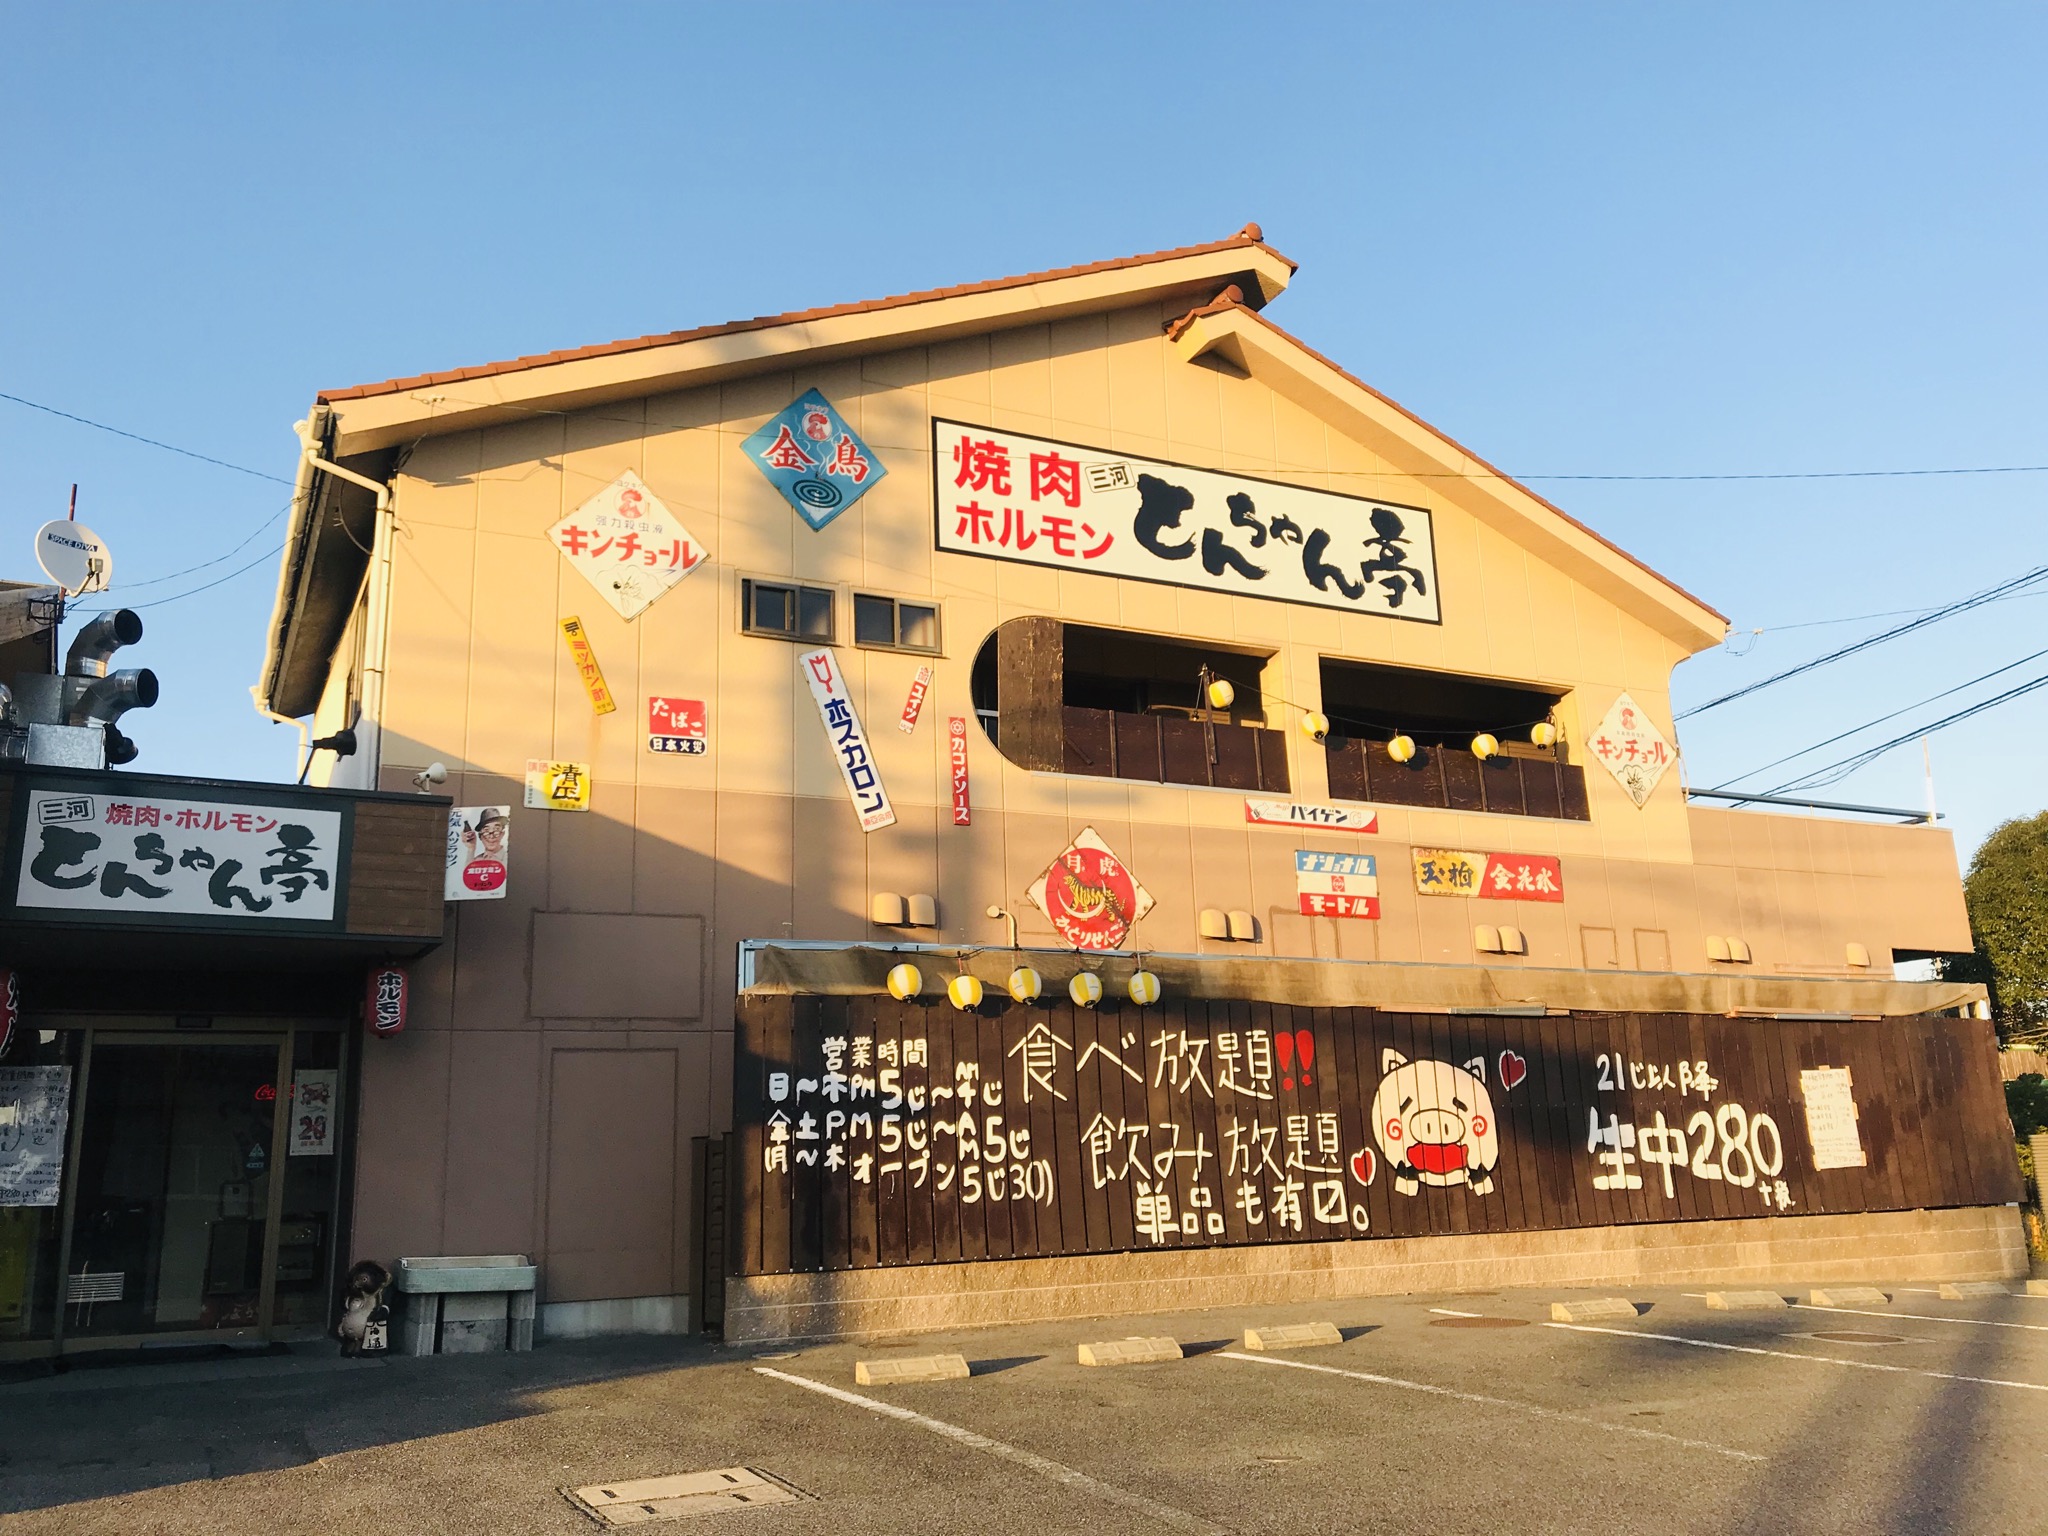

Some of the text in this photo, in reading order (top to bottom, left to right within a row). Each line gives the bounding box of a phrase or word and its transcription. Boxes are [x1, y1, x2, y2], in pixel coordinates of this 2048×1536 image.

[760, 423, 871, 484] 金鳥
[953, 435, 1082, 509] 焼肉
[1090, 465, 1129, 492] 三河
[561, 525, 698, 569] キンチョール
[954, 500, 1114, 560] ホルモン
[1133, 473, 1427, 609] とんちゃん亭
[652, 698, 704, 737] たばこ
[653, 738, 702, 753] 日本火災
[824, 698, 884, 814] ホスカロン
[1596, 735, 1668, 765] キンチョール
[951, 737, 969, 821] カゴメソース
[43, 800, 90, 820] 三河
[105, 803, 278, 834] 焼肉・ホルモン
[30, 823, 329, 912] とんちゃん亭
[1303, 854, 1370, 875] ナショナル
[1309, 895, 1370, 916] モートル
[375, 971, 403, 1030] ホルモン
[822, 1036, 928, 1071] 営業時間
[1597, 1052, 1719, 1101] 21じ以降
[1081, 1112, 1343, 1190] 飲み放題
[1588, 1103, 1784, 1199] 生中280
